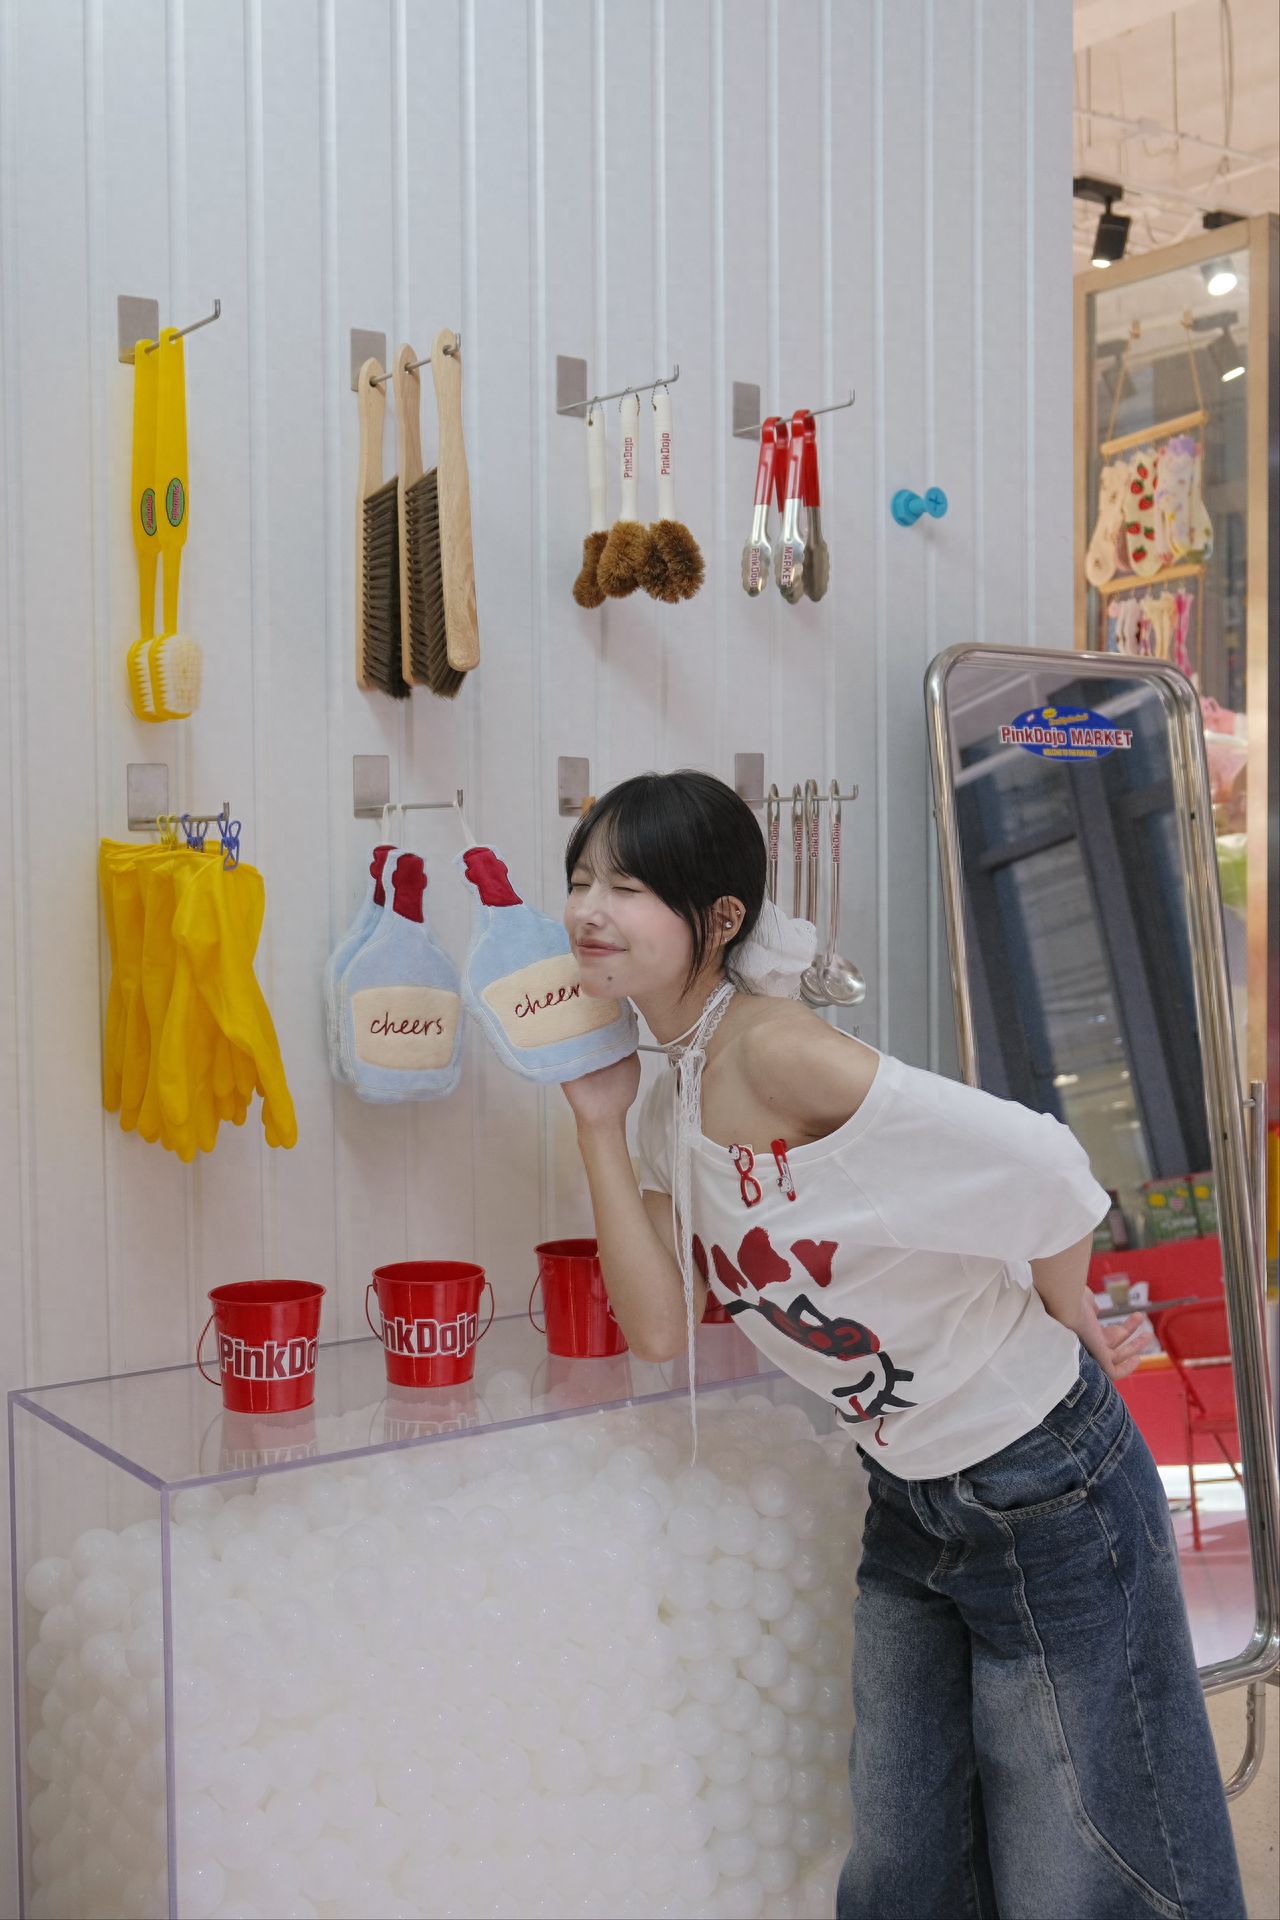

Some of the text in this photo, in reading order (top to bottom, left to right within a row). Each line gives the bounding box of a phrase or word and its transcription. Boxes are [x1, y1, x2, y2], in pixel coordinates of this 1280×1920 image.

[624, 437, 634, 478] PinkDojo
[660, 432, 672, 475] PinkDojo
[782, 546, 793, 588] MARKET
[999, 725, 1133, 748] PinkDojo MARKET
[369, 1011, 444, 1037] cheers
